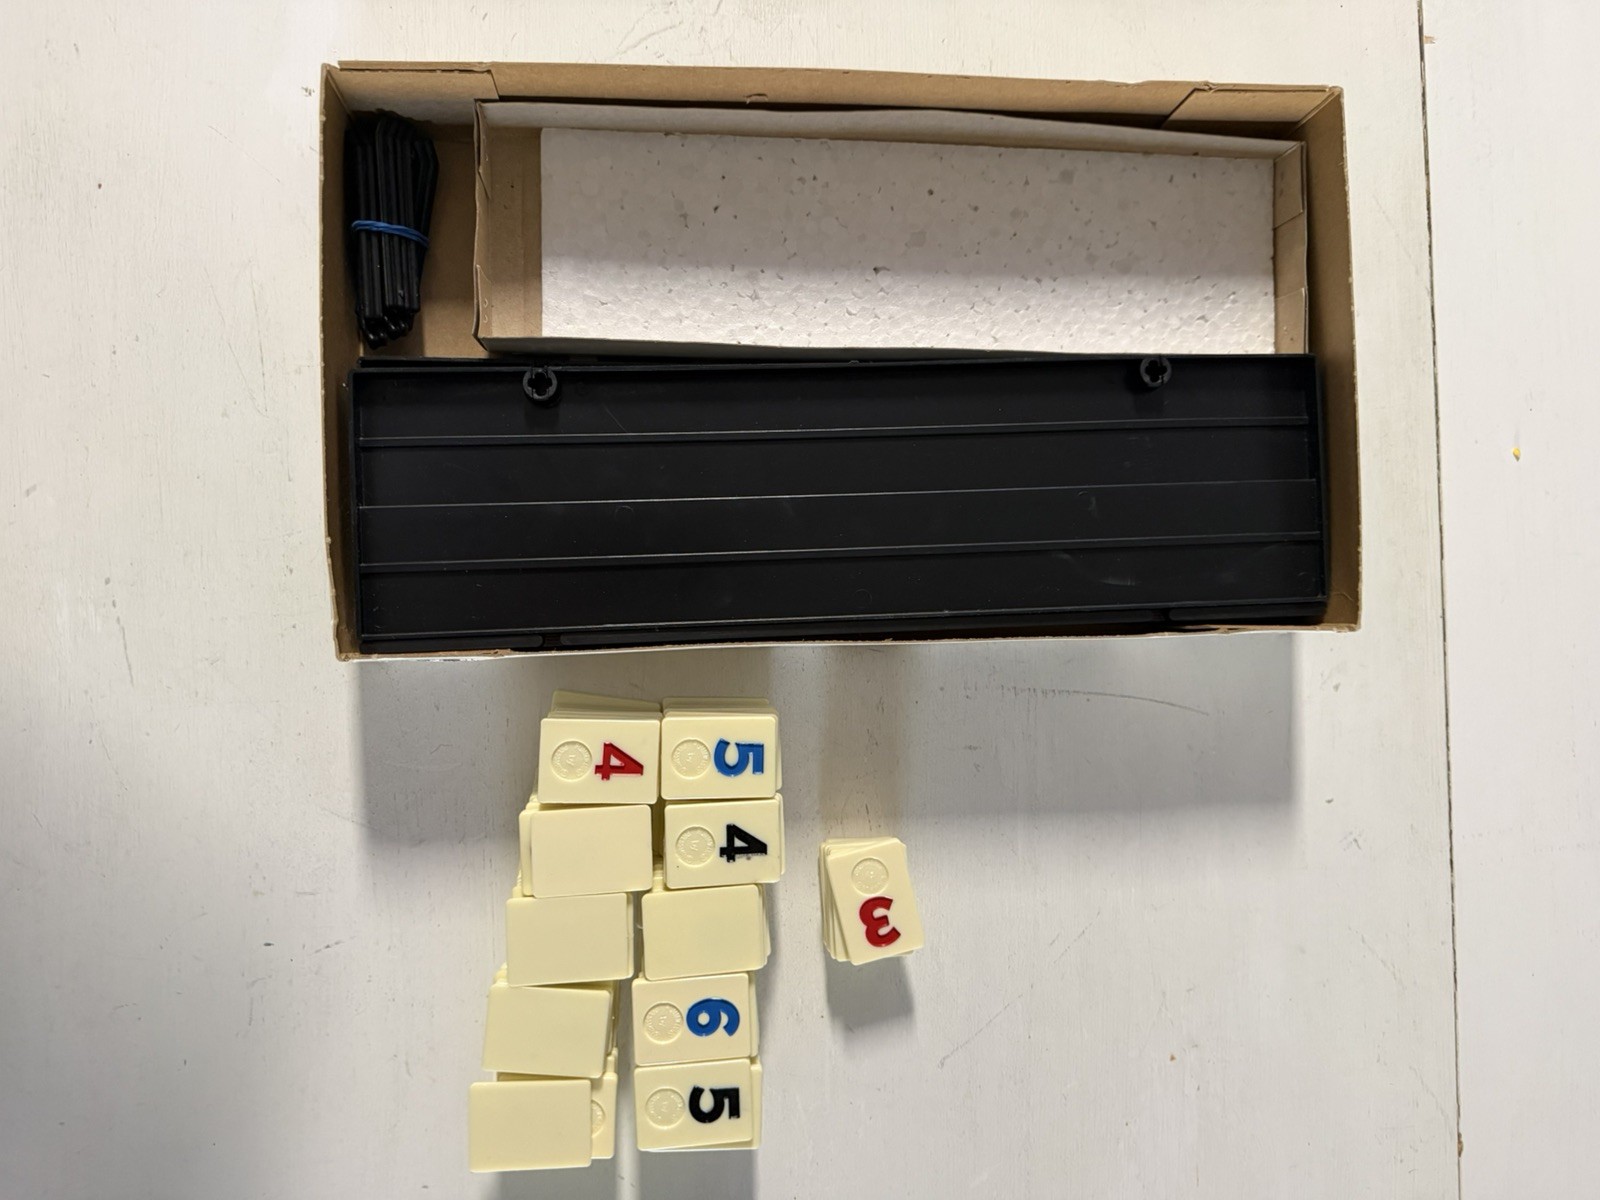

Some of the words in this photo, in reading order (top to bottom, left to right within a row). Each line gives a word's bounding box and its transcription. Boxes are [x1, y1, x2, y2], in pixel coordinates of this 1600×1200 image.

[595, 742, 644, 781] 4
[714, 738, 764, 777] 5
[719, 823, 768, 863] 4
[859, 896, 901, 948] 3
[686, 997, 740, 1037] 6
[688, 1085, 741, 1124] 5
